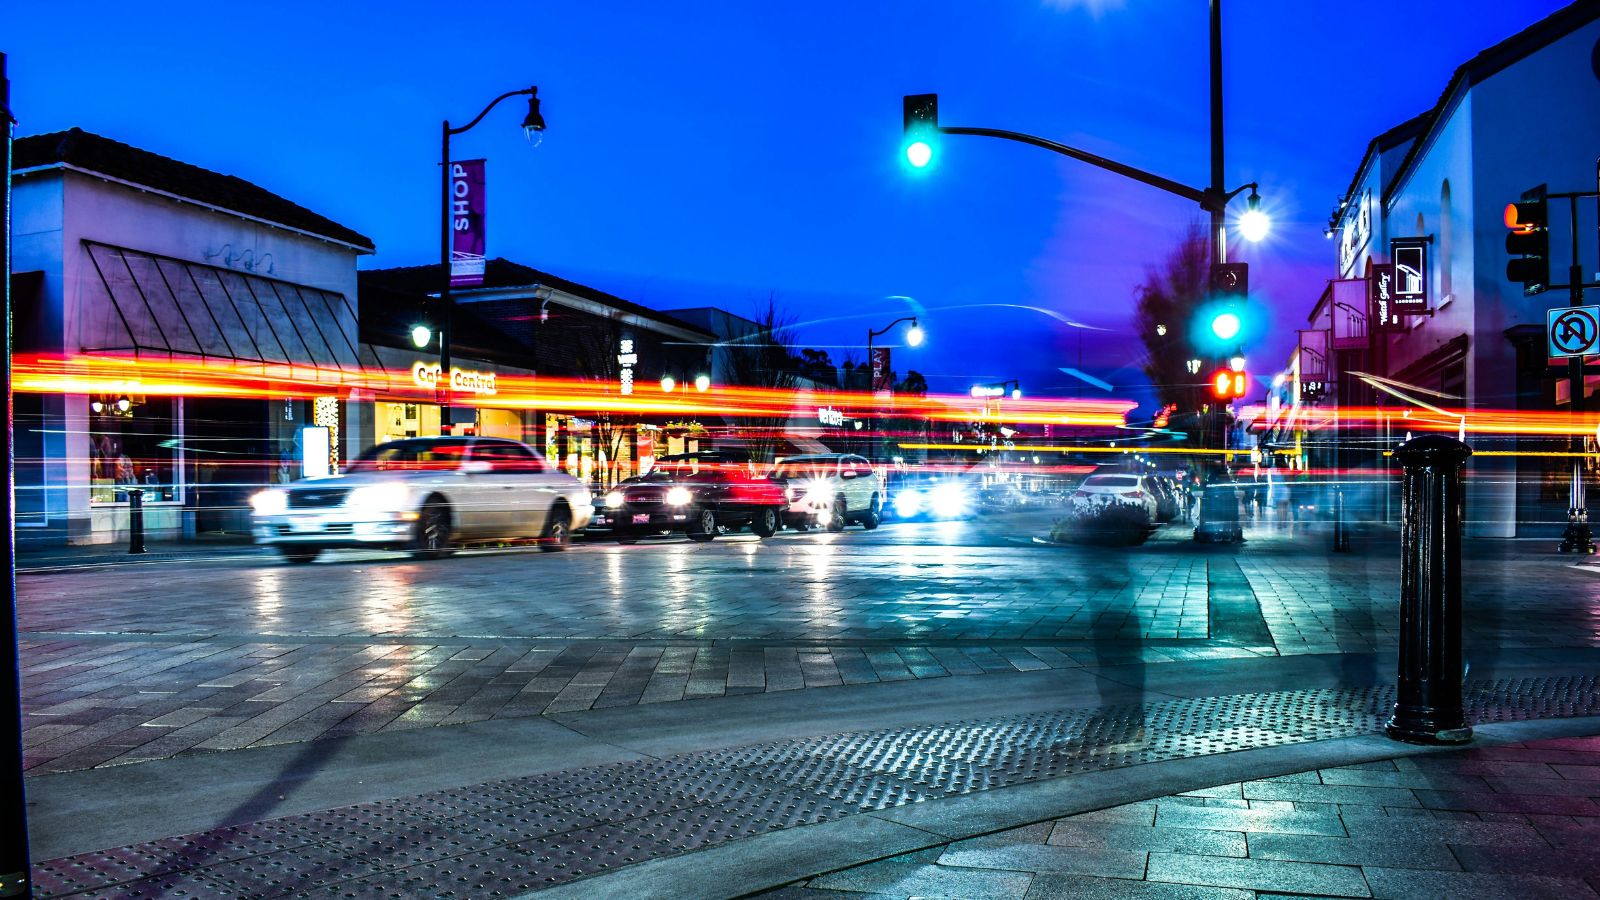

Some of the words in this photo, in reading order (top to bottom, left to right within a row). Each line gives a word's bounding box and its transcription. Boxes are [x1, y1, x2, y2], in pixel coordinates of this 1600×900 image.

[453, 164, 469, 231] SHOP
[873, 350, 882, 378] PLAY
[453, 370, 497, 391] Central
